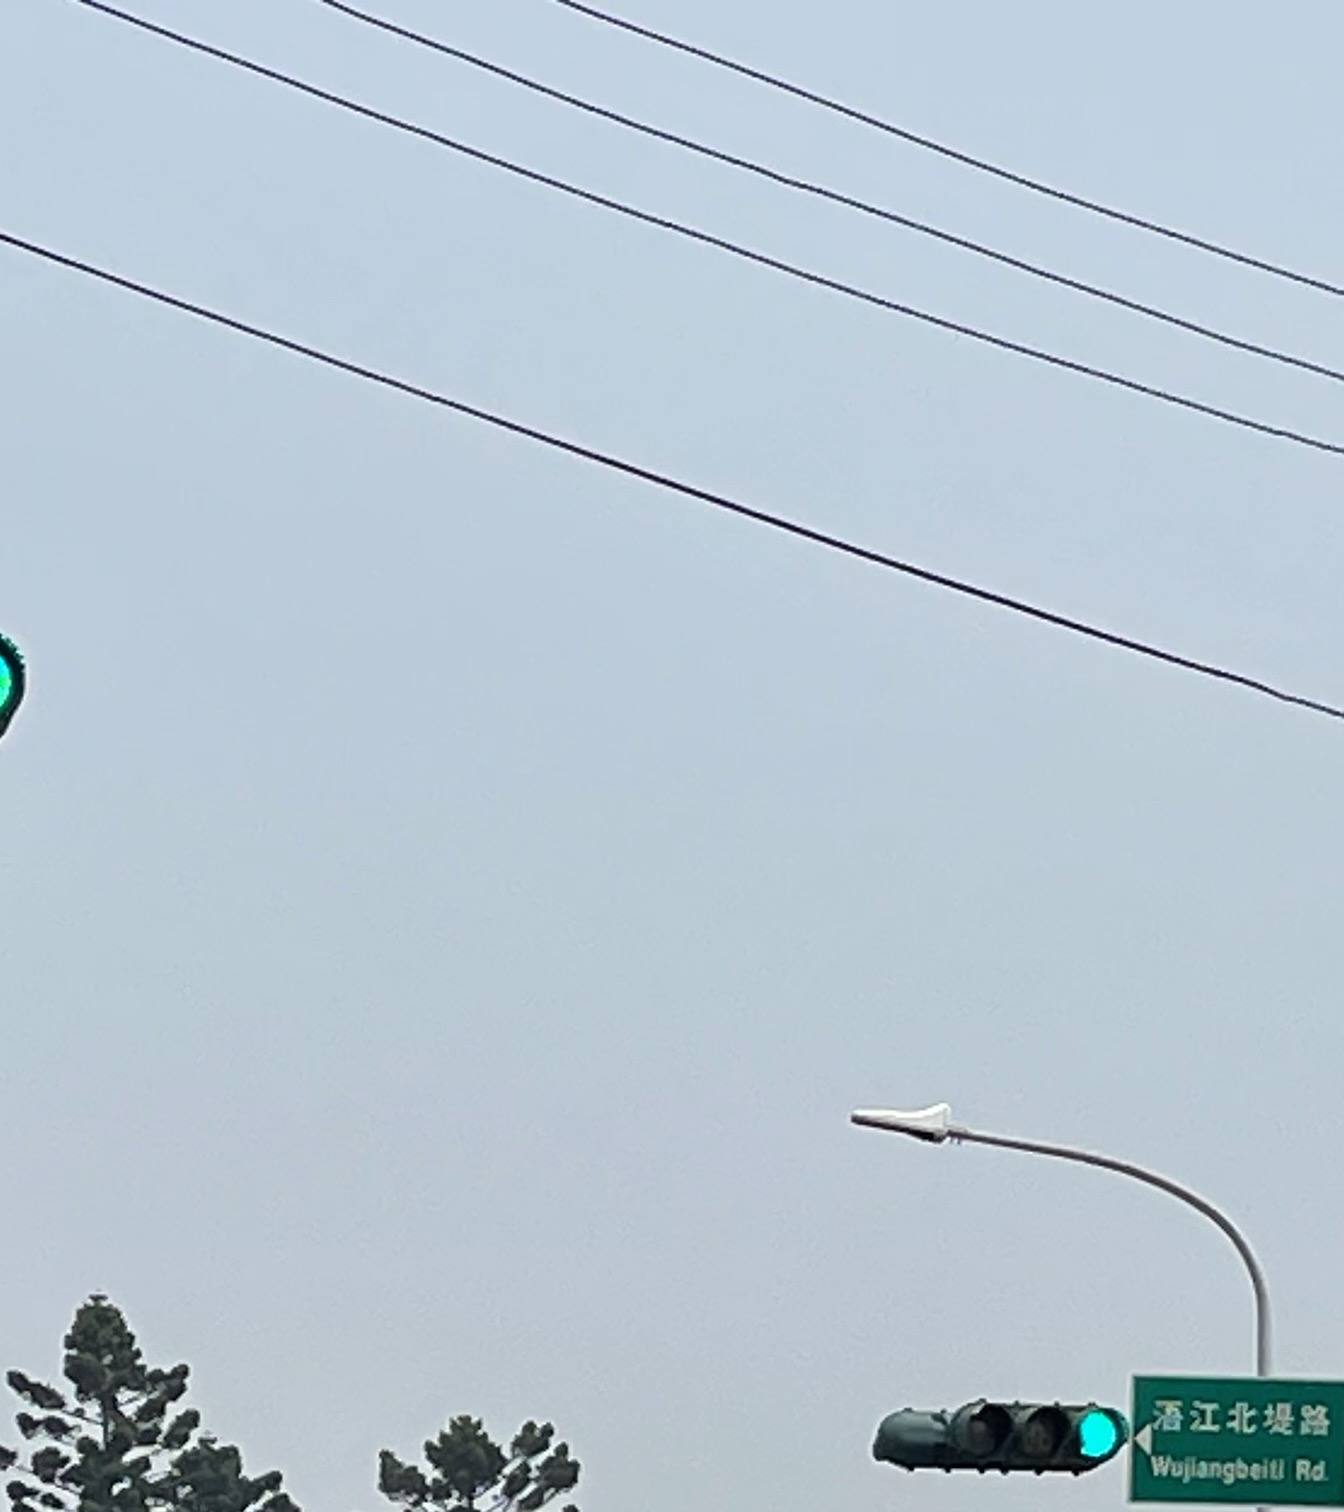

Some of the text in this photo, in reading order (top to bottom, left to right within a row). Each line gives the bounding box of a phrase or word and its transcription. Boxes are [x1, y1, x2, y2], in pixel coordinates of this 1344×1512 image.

[1152, 1400, 1331, 1436] 浯江北堤路
[1151, 1455, 1329, 1484] Wujiangbeiti Rd.
